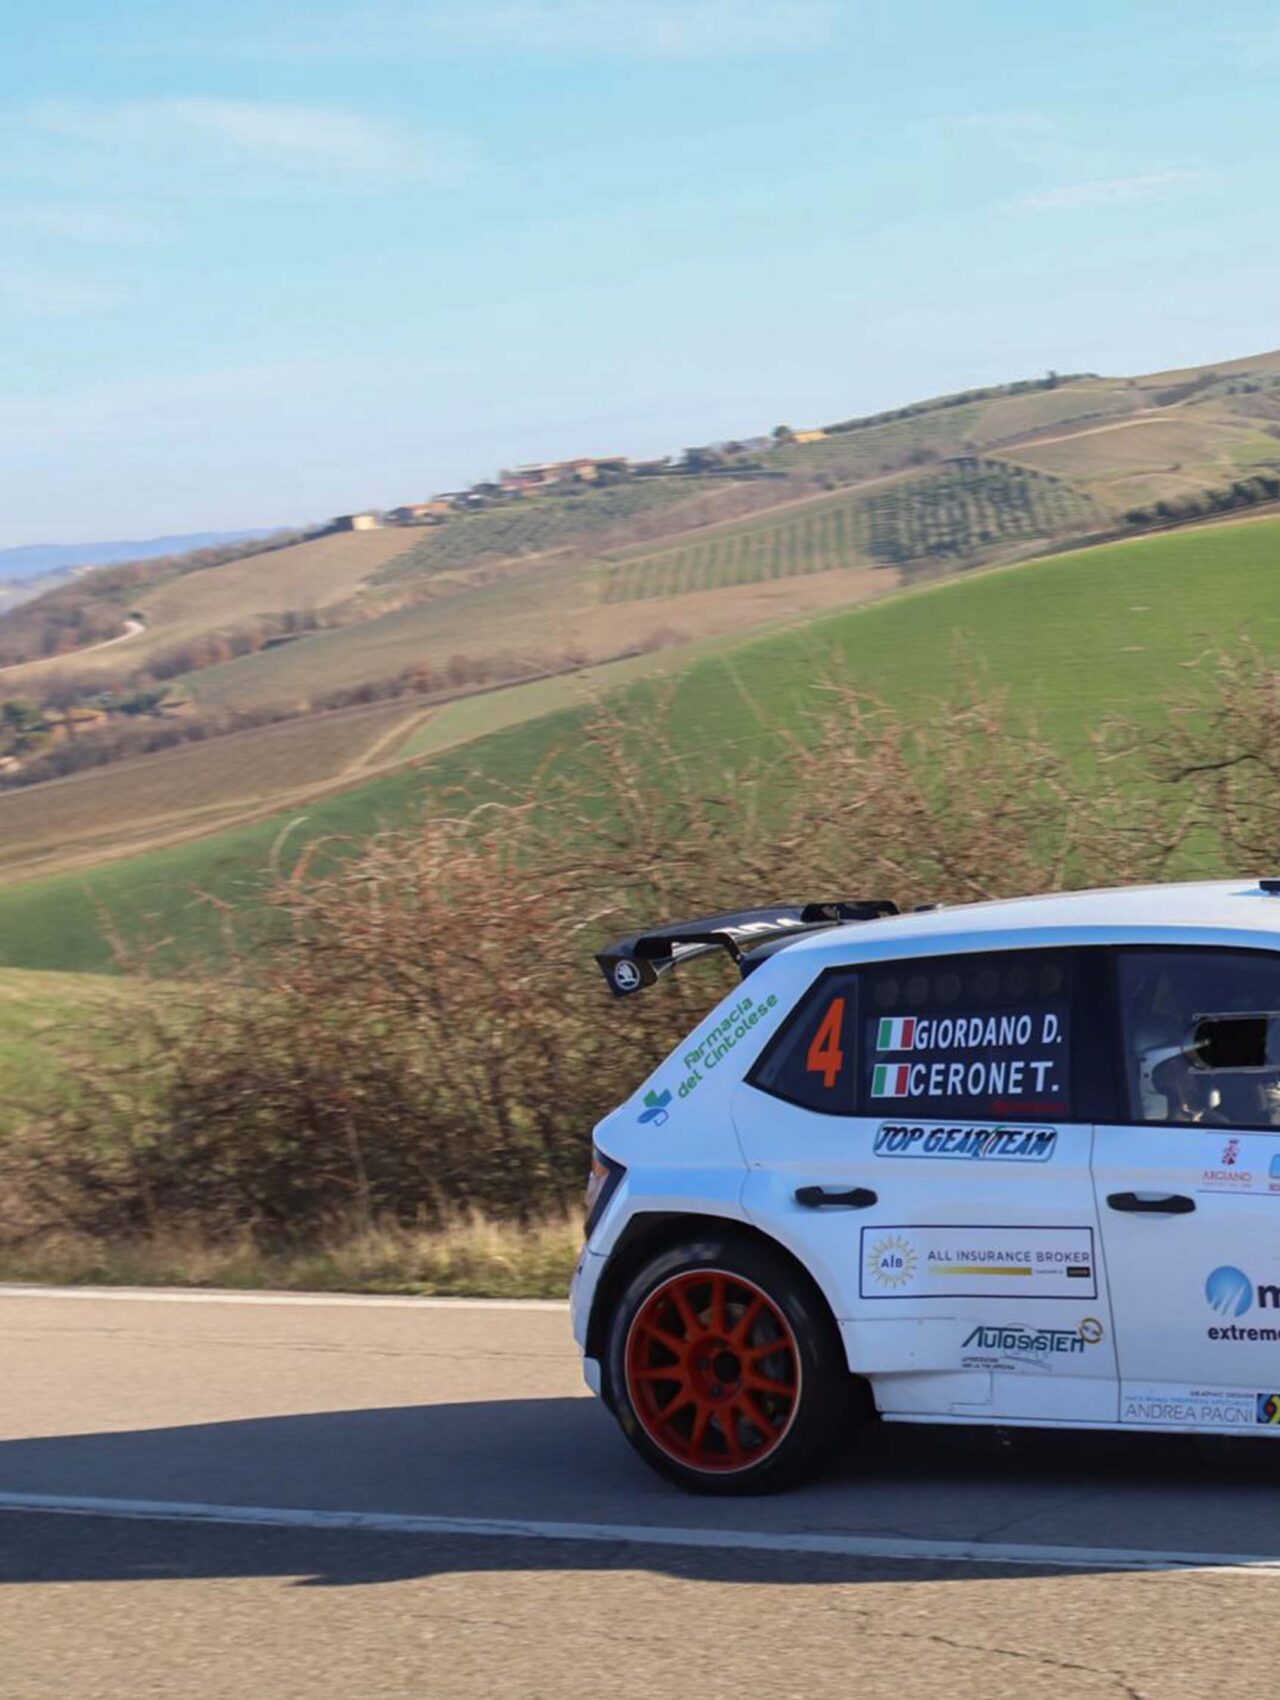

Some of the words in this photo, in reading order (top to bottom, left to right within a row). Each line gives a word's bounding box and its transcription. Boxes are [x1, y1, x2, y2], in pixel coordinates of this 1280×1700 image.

[677, 1070, 703, 1099] del
[704, 994, 778, 1069] Cintolese
[683, 997, 753, 1070] Farmacia
[806, 997, 846, 1088] 4
[914, 1015, 1032, 1050] GIORDANO
[1041, 1014, 1062, 1044] D.
[909, 1062, 1024, 1097] CERONE
[1030, 1061, 1060, 1092] T.
[874, 1126, 924, 1152] TOP
[986, 1129, 1057, 1157] TEAM
[928, 1250, 952, 1262] ALL
[956, 1251, 1032, 1262] INSURANCE
[1036, 1251, 1090, 1263] BROKER
[1125, 1403, 1196, 1421] ANDREA
[1201, 1406, 1253, 1423] PAGNI
